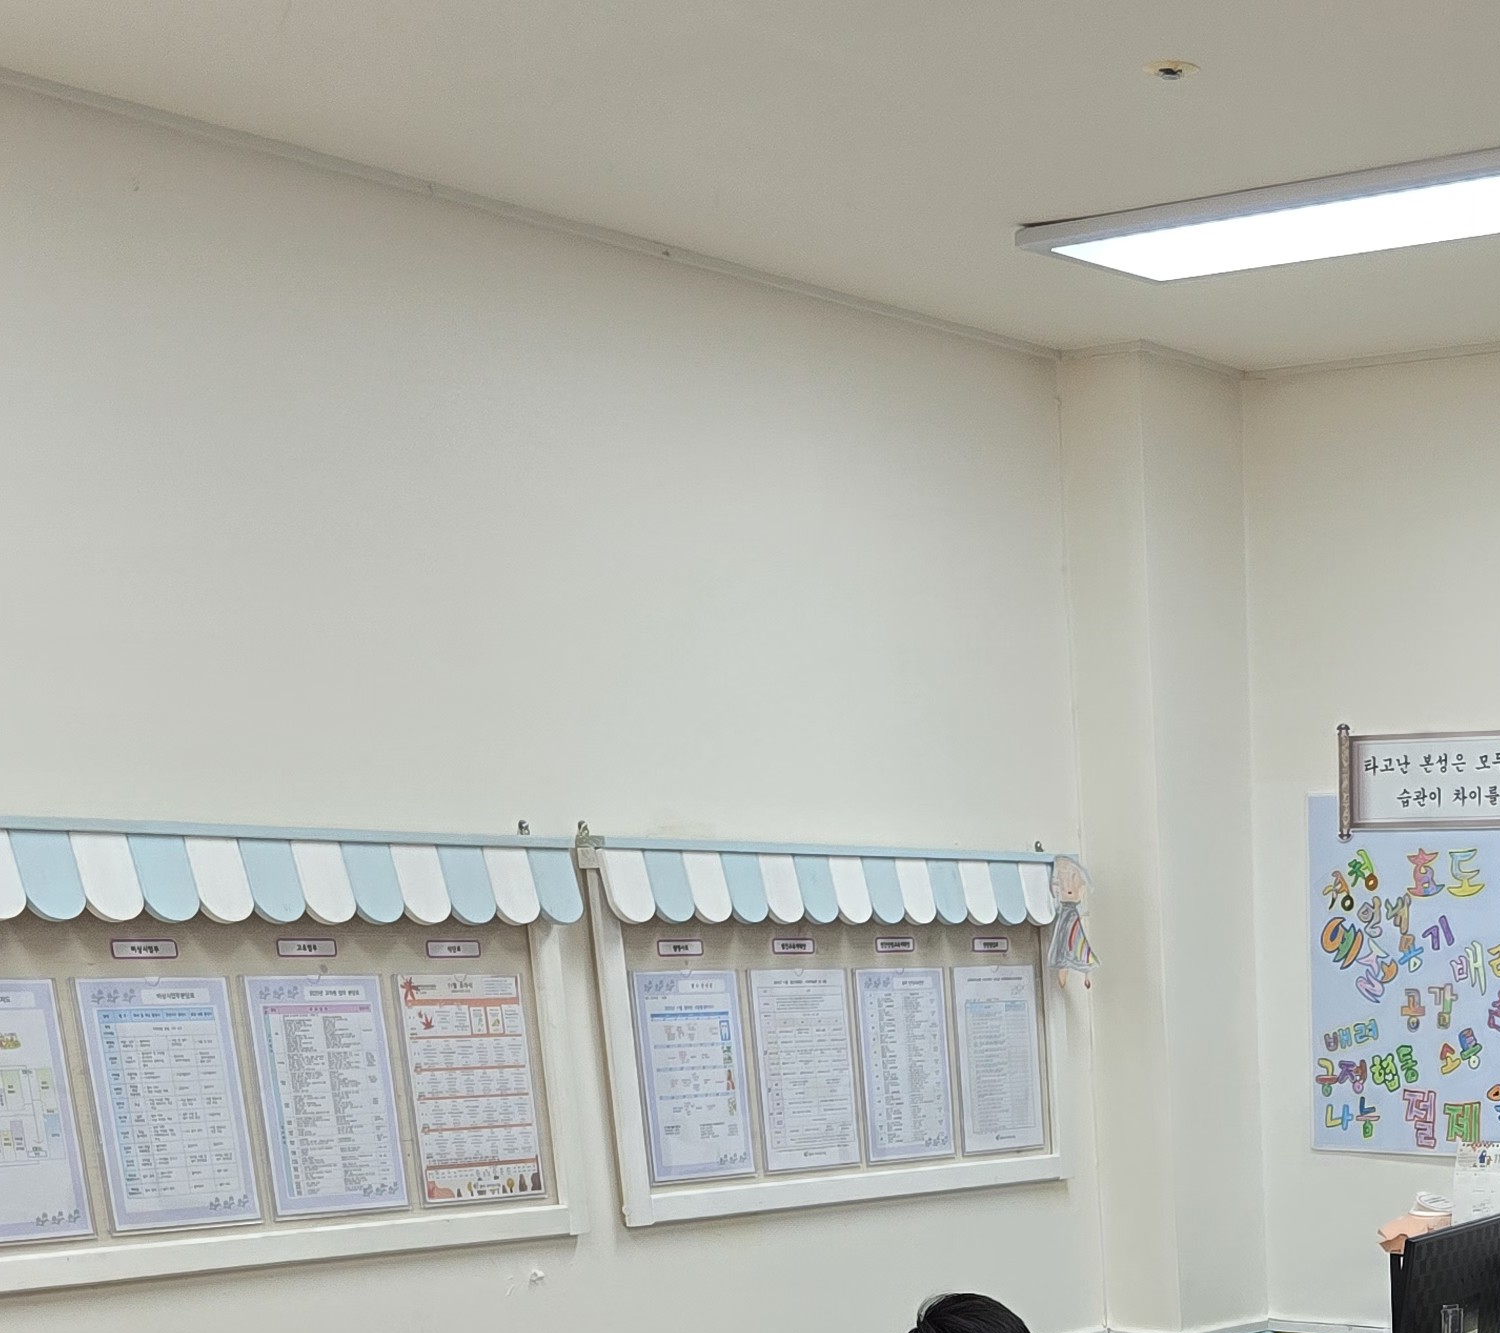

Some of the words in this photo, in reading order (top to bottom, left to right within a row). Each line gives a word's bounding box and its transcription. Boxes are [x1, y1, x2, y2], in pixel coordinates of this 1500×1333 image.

[1363, 753, 1411, 776] 타고난
[1419, 752, 1467, 774] 본성은
[1396, 786, 1442, 808] 습관이
[1452, 785, 1500, 807] 차이를
[1406, 847, 1486, 898] 효도
[1398, 915, 1455, 974] 용기
[1401, 983, 1458, 1032] 공감
[1324, 1019, 1379, 1052] 배려
[1440, 1028, 1482, 1075] 소통
[1315, 1057, 1367, 1097] 긍정
[1370, 1044, 1419, 1093] 협동
[1325, 1096, 1380, 1138] 나눔
[1402, 1088, 1481, 1149] 절제
